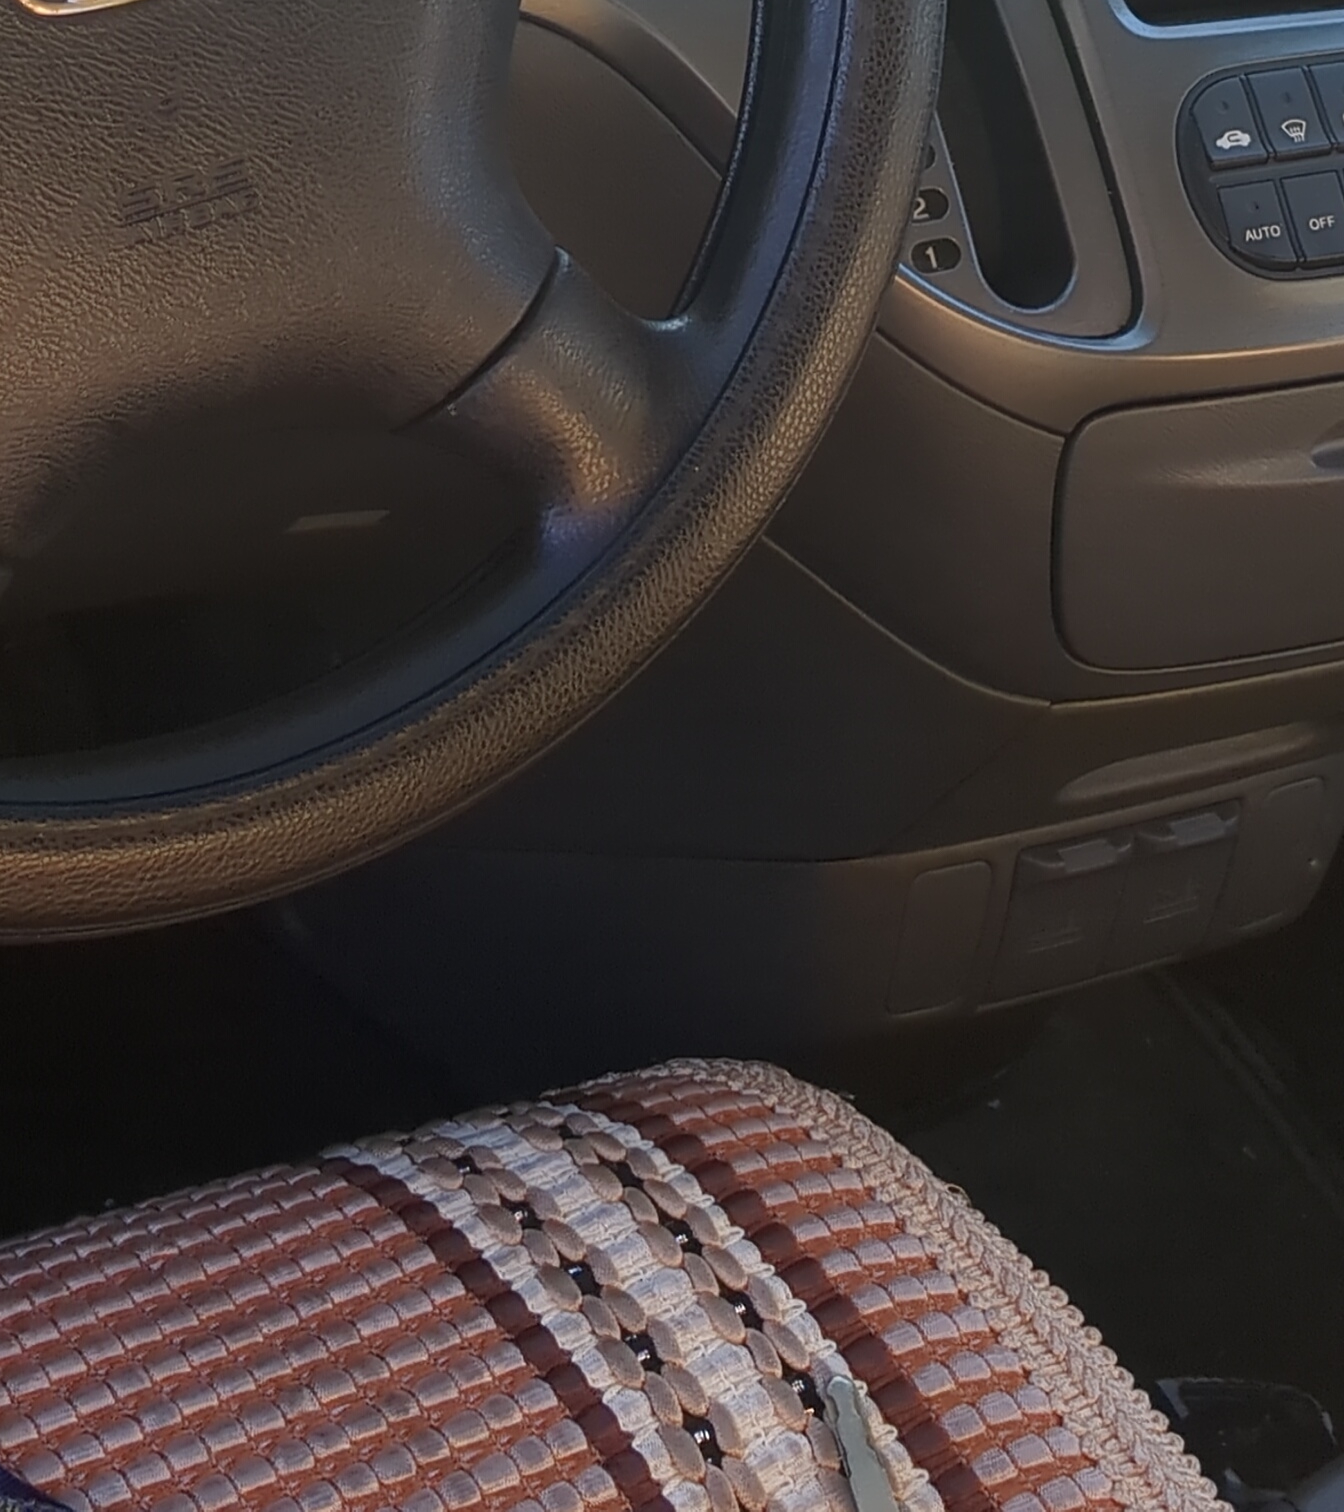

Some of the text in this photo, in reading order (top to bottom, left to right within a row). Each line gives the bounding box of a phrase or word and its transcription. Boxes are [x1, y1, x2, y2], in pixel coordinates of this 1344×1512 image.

[913, 197, 929, 219] 2
[1245, 224, 1281, 242] AUTO
[1309, 215, 1336, 231] OFF
[925, 246, 938, 269] 1
